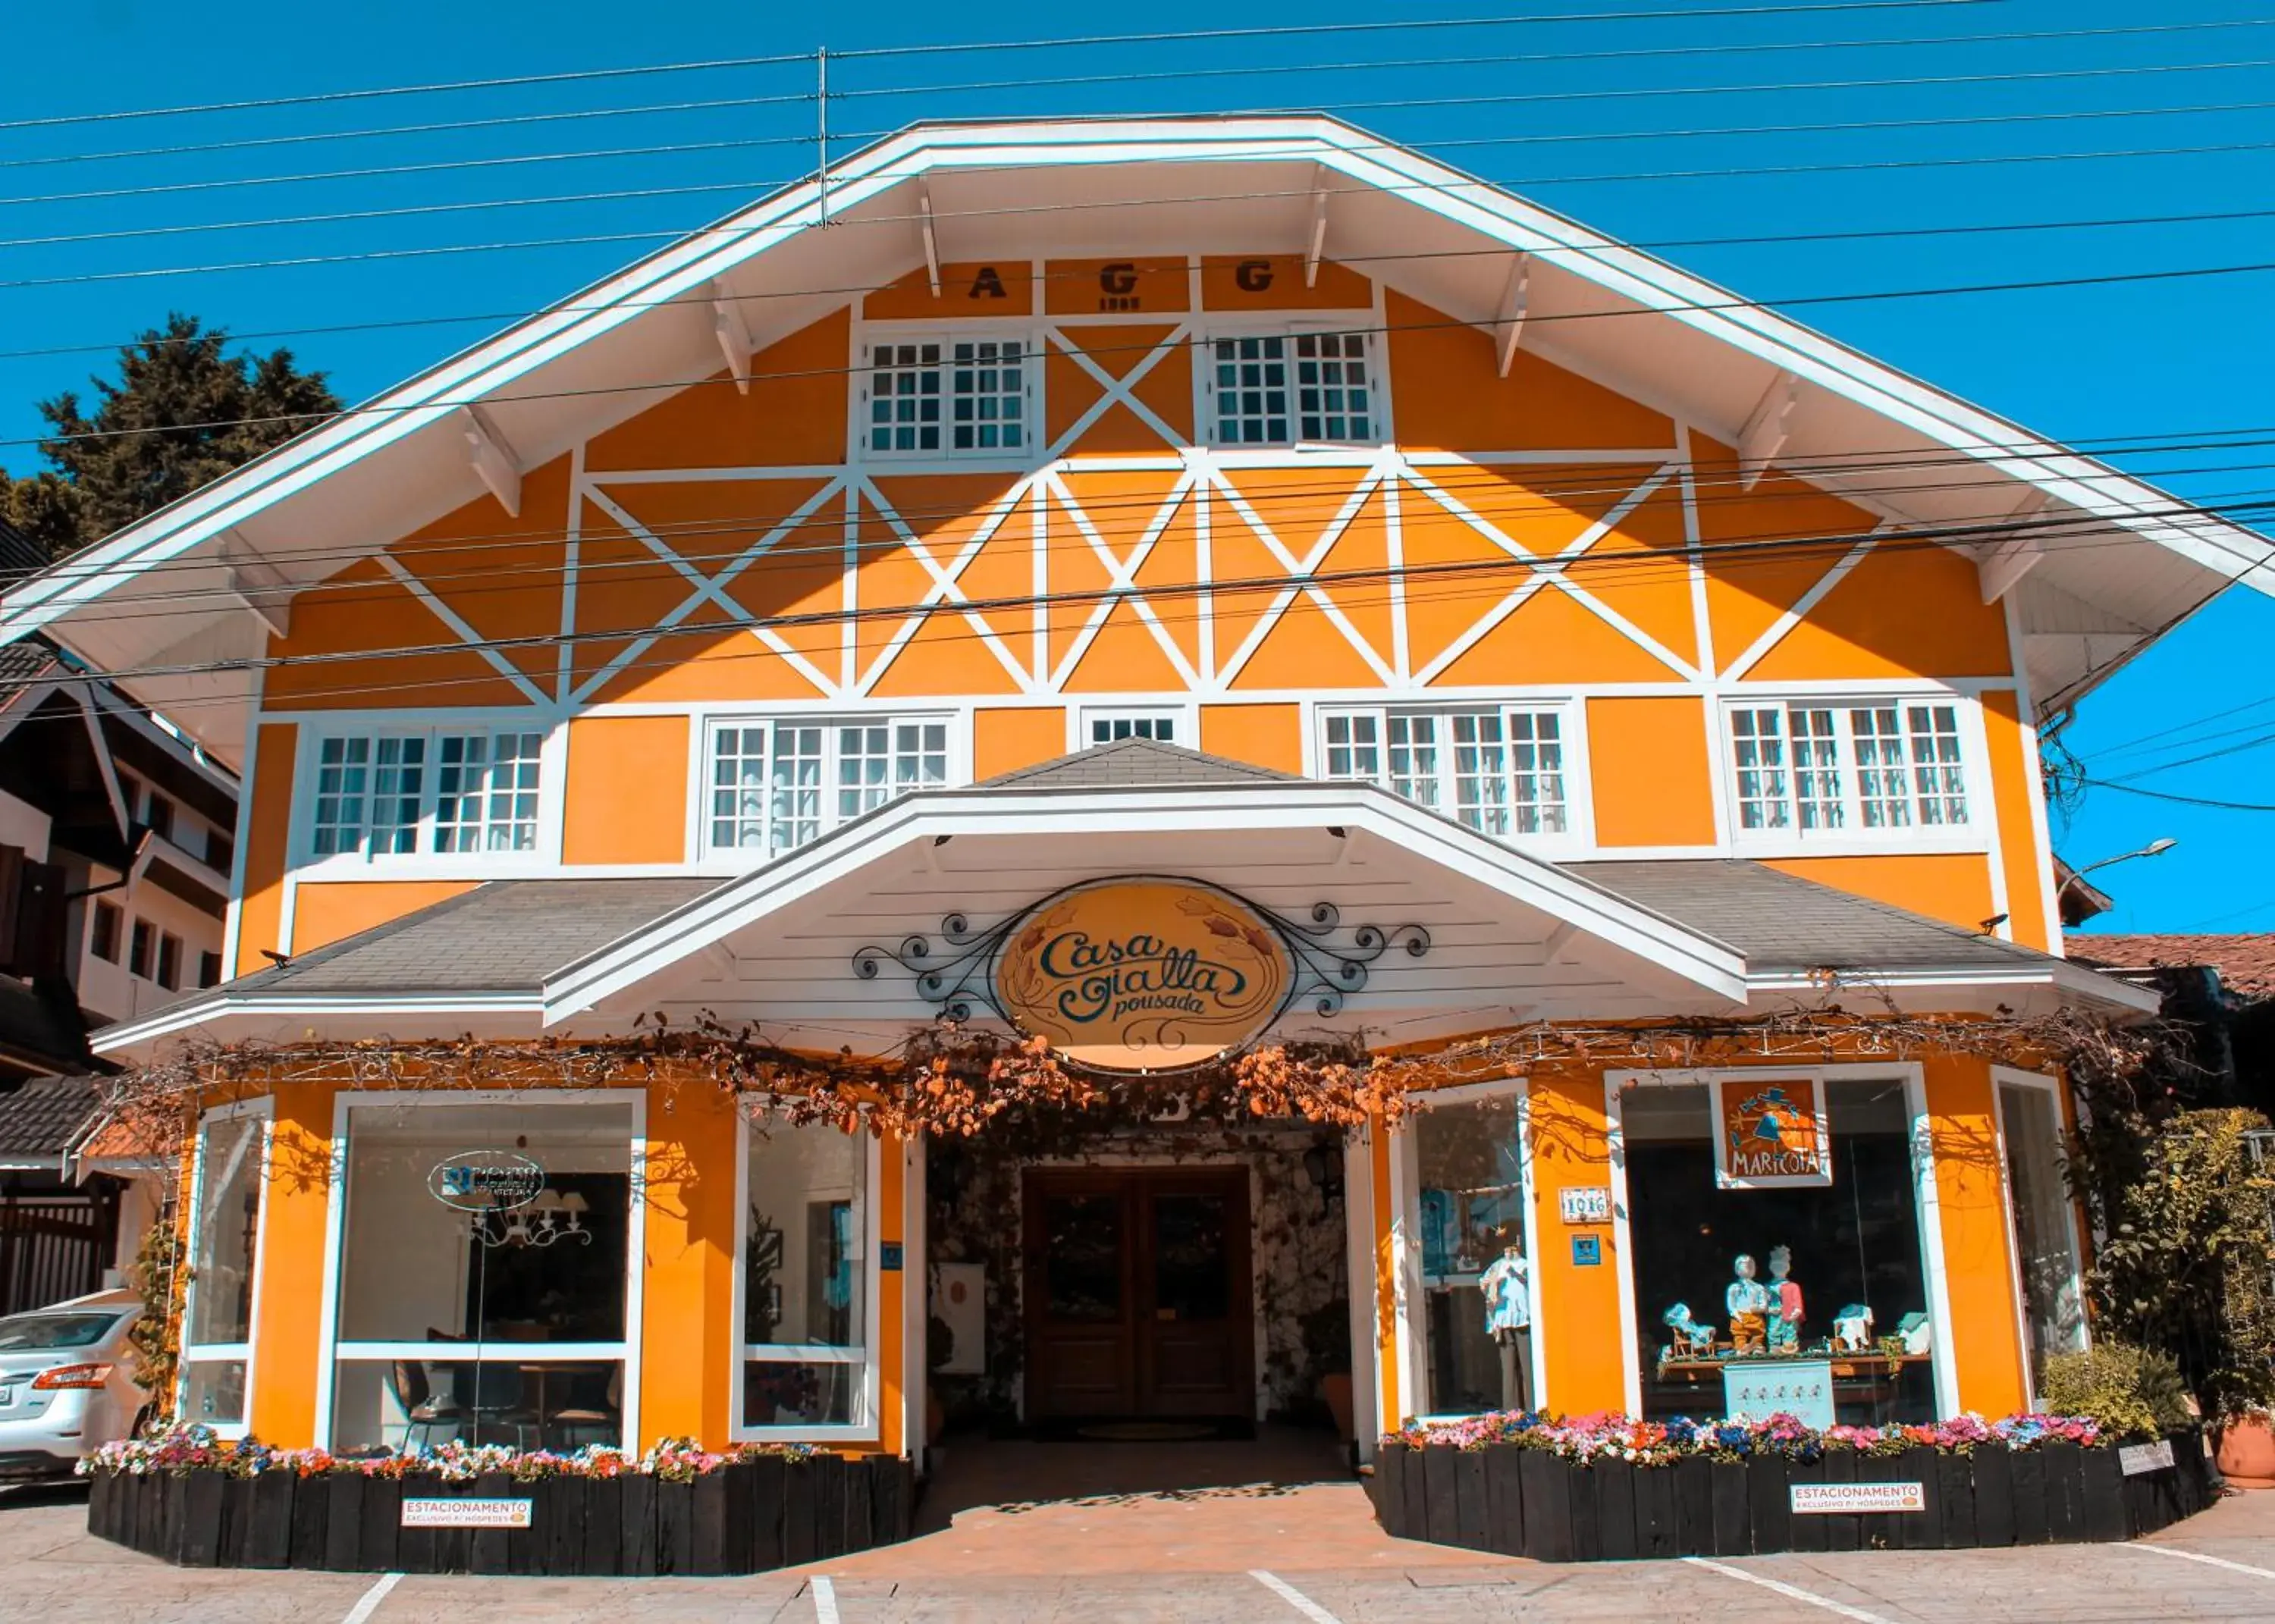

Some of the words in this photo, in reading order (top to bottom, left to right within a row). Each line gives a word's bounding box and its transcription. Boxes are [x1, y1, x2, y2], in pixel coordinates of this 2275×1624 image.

[968, 267, 1007, 299] A
[1100, 263, 1138, 295] G
[1235, 260, 1274, 293] G
[1040, 930, 1164, 979] Casa
[1111, 992, 1207, 1024] pousada
[1567, 1196, 1605, 1214] 1016
[1795, 1486, 1918, 1499] ESTACIONAMENTO
[406, 1502, 527, 1513] ESTACIONAMENTO
